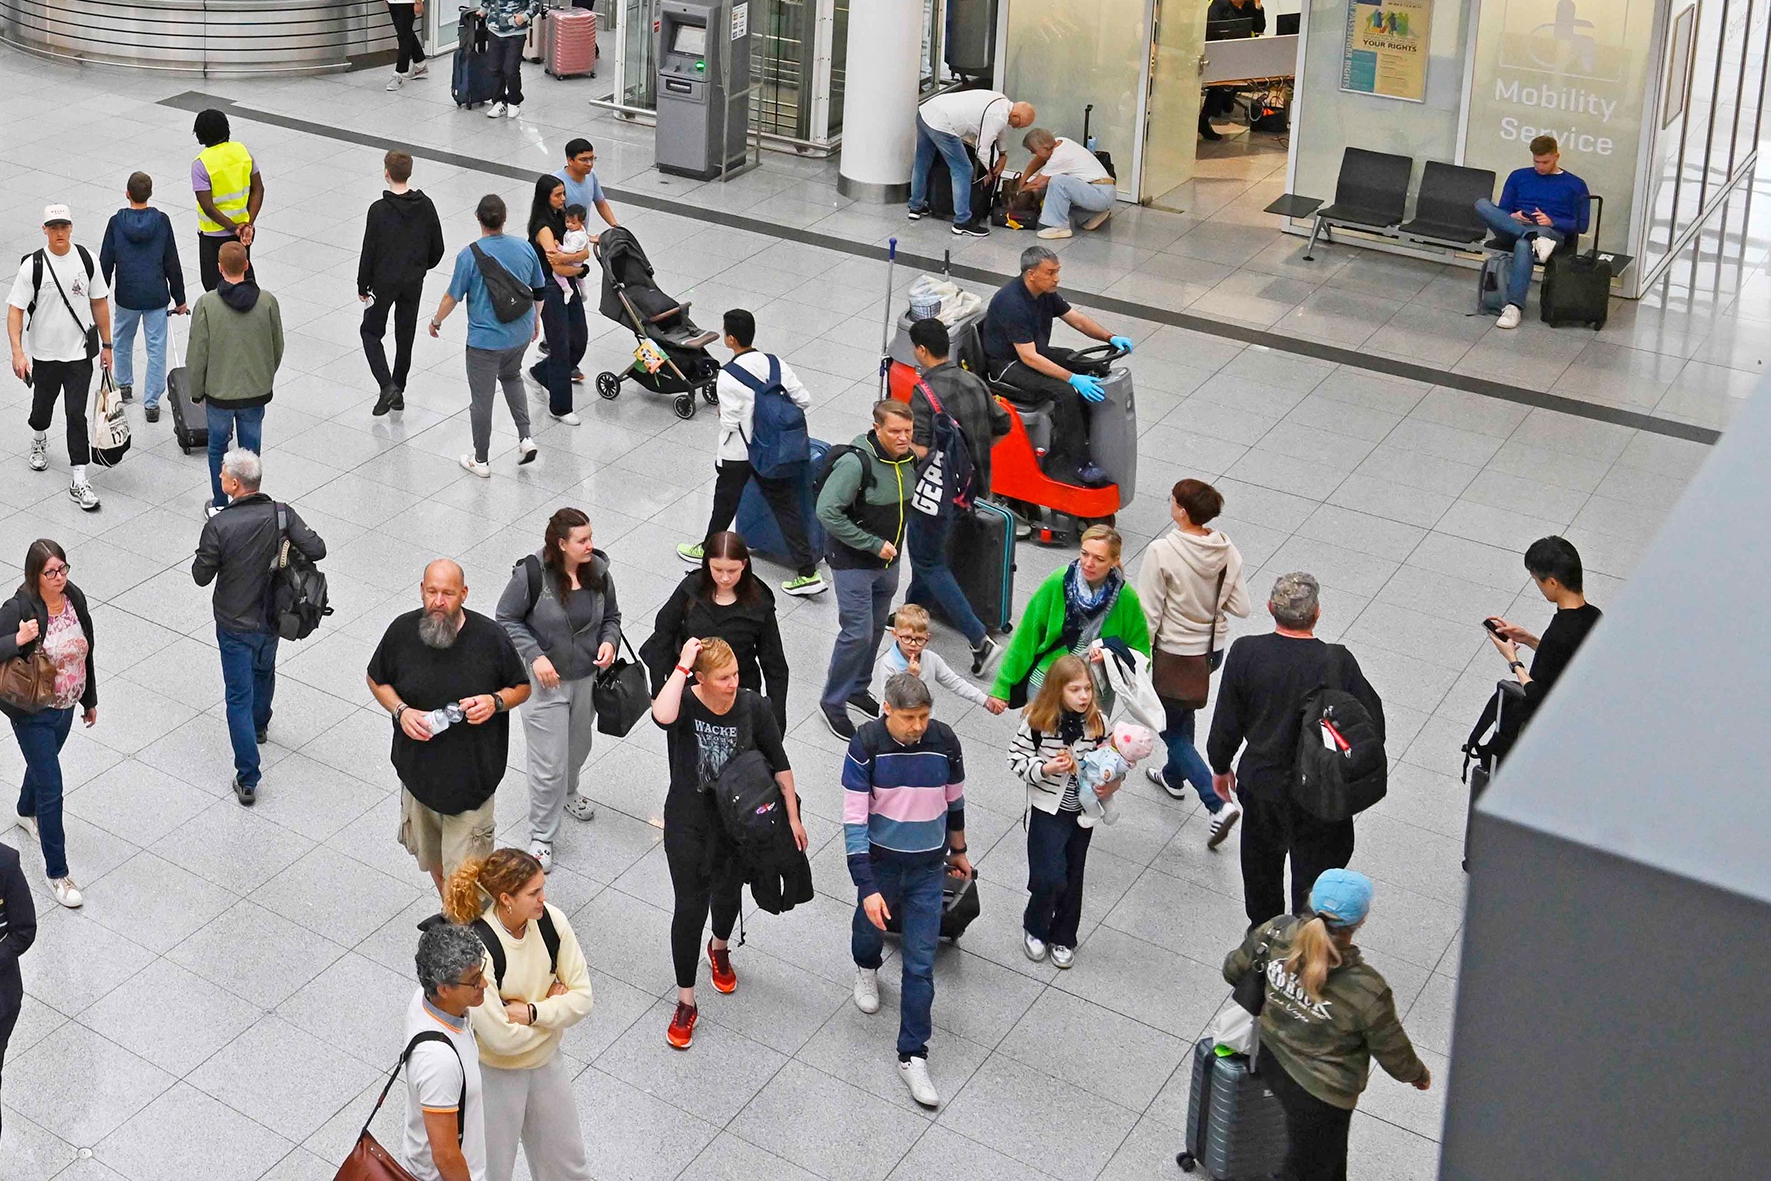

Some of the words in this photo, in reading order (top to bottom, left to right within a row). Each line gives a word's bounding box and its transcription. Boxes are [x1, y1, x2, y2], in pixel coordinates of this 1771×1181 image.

[1346, 11, 1356, 59] PASSENGER
[1362, 39, 1386, 49] YOUR
[1387, 43, 1418, 53] RIGHTS
[1342, 59, 1352, 89] RIGHTS
[1494, 77, 1618, 123] Mobility
[694, 719, 738, 738] WACKE
